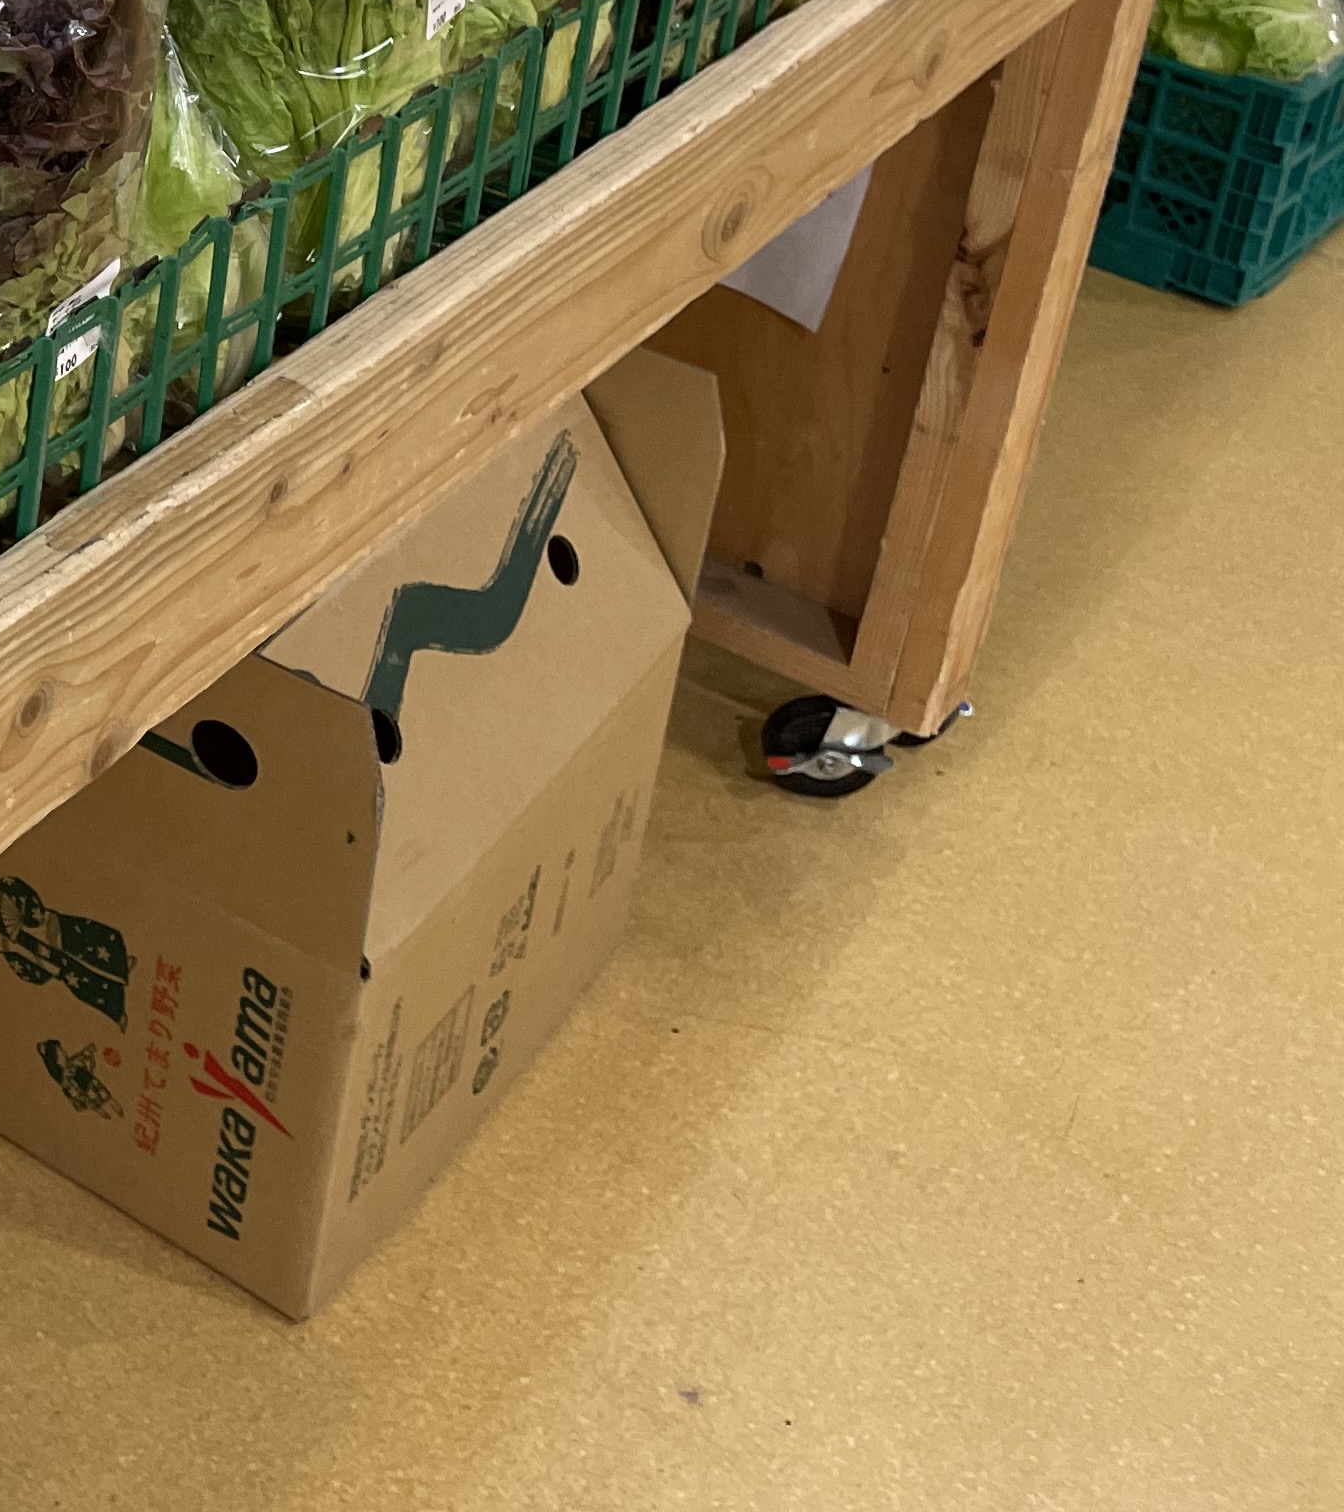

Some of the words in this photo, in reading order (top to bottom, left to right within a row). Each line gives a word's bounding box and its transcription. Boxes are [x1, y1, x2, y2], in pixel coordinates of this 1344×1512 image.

[133, 953, 184, 1157] 紀州てまり野菜
